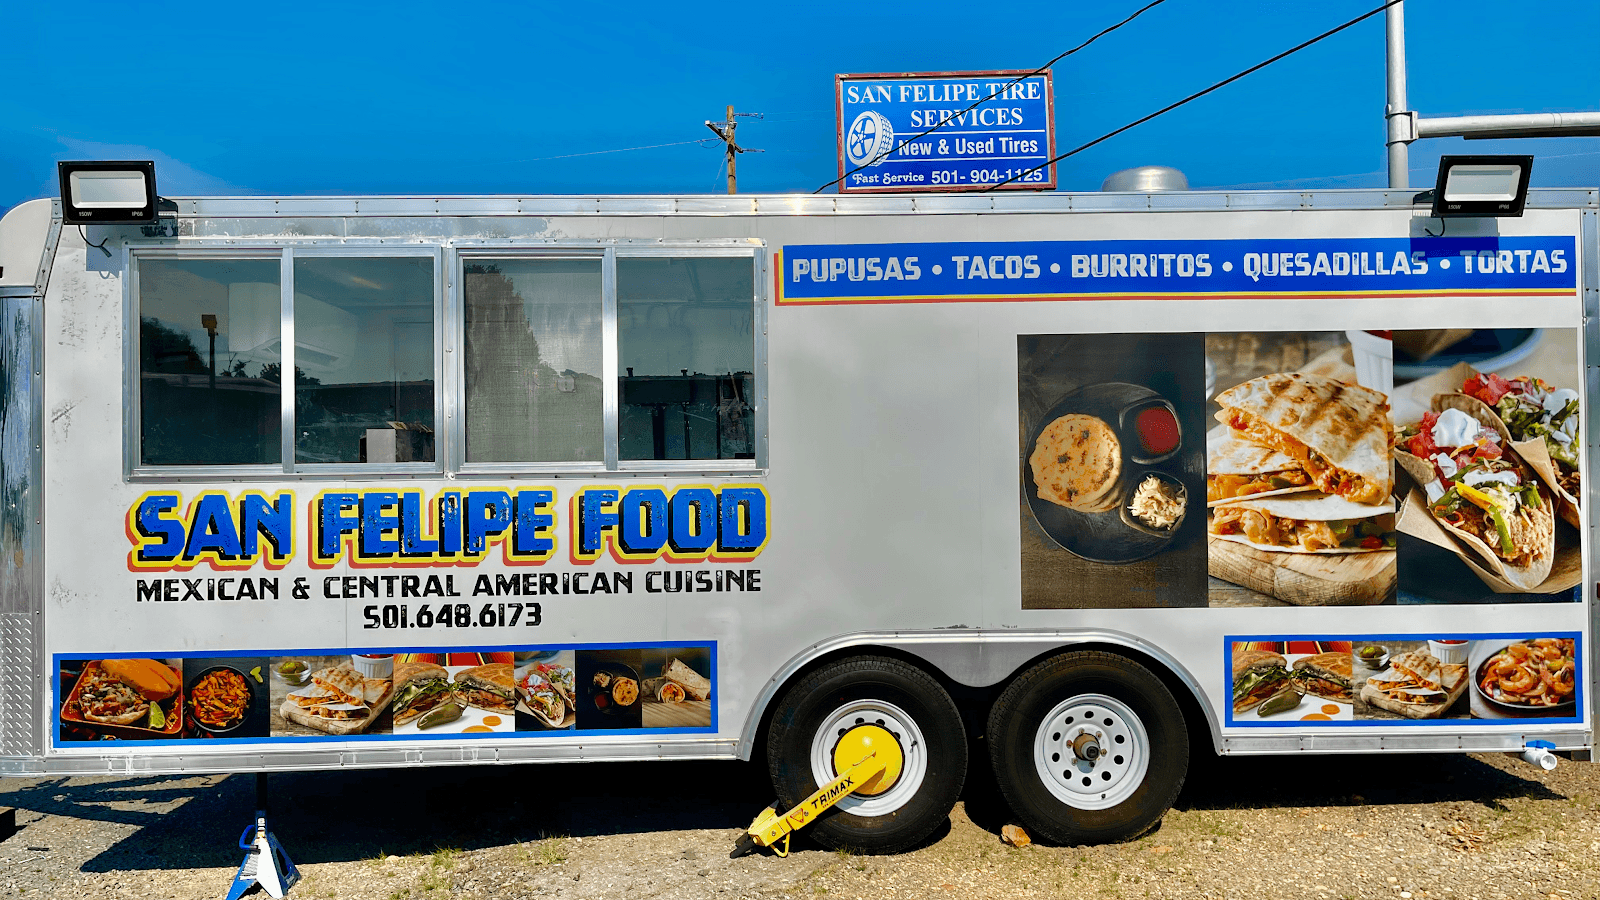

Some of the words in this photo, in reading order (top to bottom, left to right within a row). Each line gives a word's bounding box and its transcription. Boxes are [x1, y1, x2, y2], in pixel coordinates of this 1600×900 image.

[847, 85, 893, 104] SAN
[898, 82, 980, 103] FELIPE
[985, 81, 1041, 101] TIRE
[910, 107, 1024, 128] SERVICES
[898, 139, 932, 156] New
[937, 138, 950, 155] &
[955, 137, 994, 155] Used
[998, 136, 1039, 154] Tires
[852, 173, 879, 185] Fast
[882, 172, 925, 185] Service
[931, 170, 966, 184] 501-
[970, 168, 1043, 183] 904-1125
[792, 256, 921, 283] PUPUSAS
[951, 254, 1040, 280] TACOS
[1071, 252, 1213, 279] BURRITOS
[1243, 250, 1429, 283] QUESADILLAS
[1460, 249, 1568, 275] TORTAS
[127, 490, 296, 570] SAN
[309, 486, 557, 567] FELIPE
[570, 484, 770, 565] FOOD
[136, 577, 279, 602] MEXICAN
[291, 576, 311, 600] &
[323, 573, 461, 599] CENTRAL
[472, 571, 633, 597] AMERICAN
[645, 569, 762, 594] CUISINE
[363, 602, 542, 629] 501.648.6173
[811, 776, 854, 809] TRIMAX
